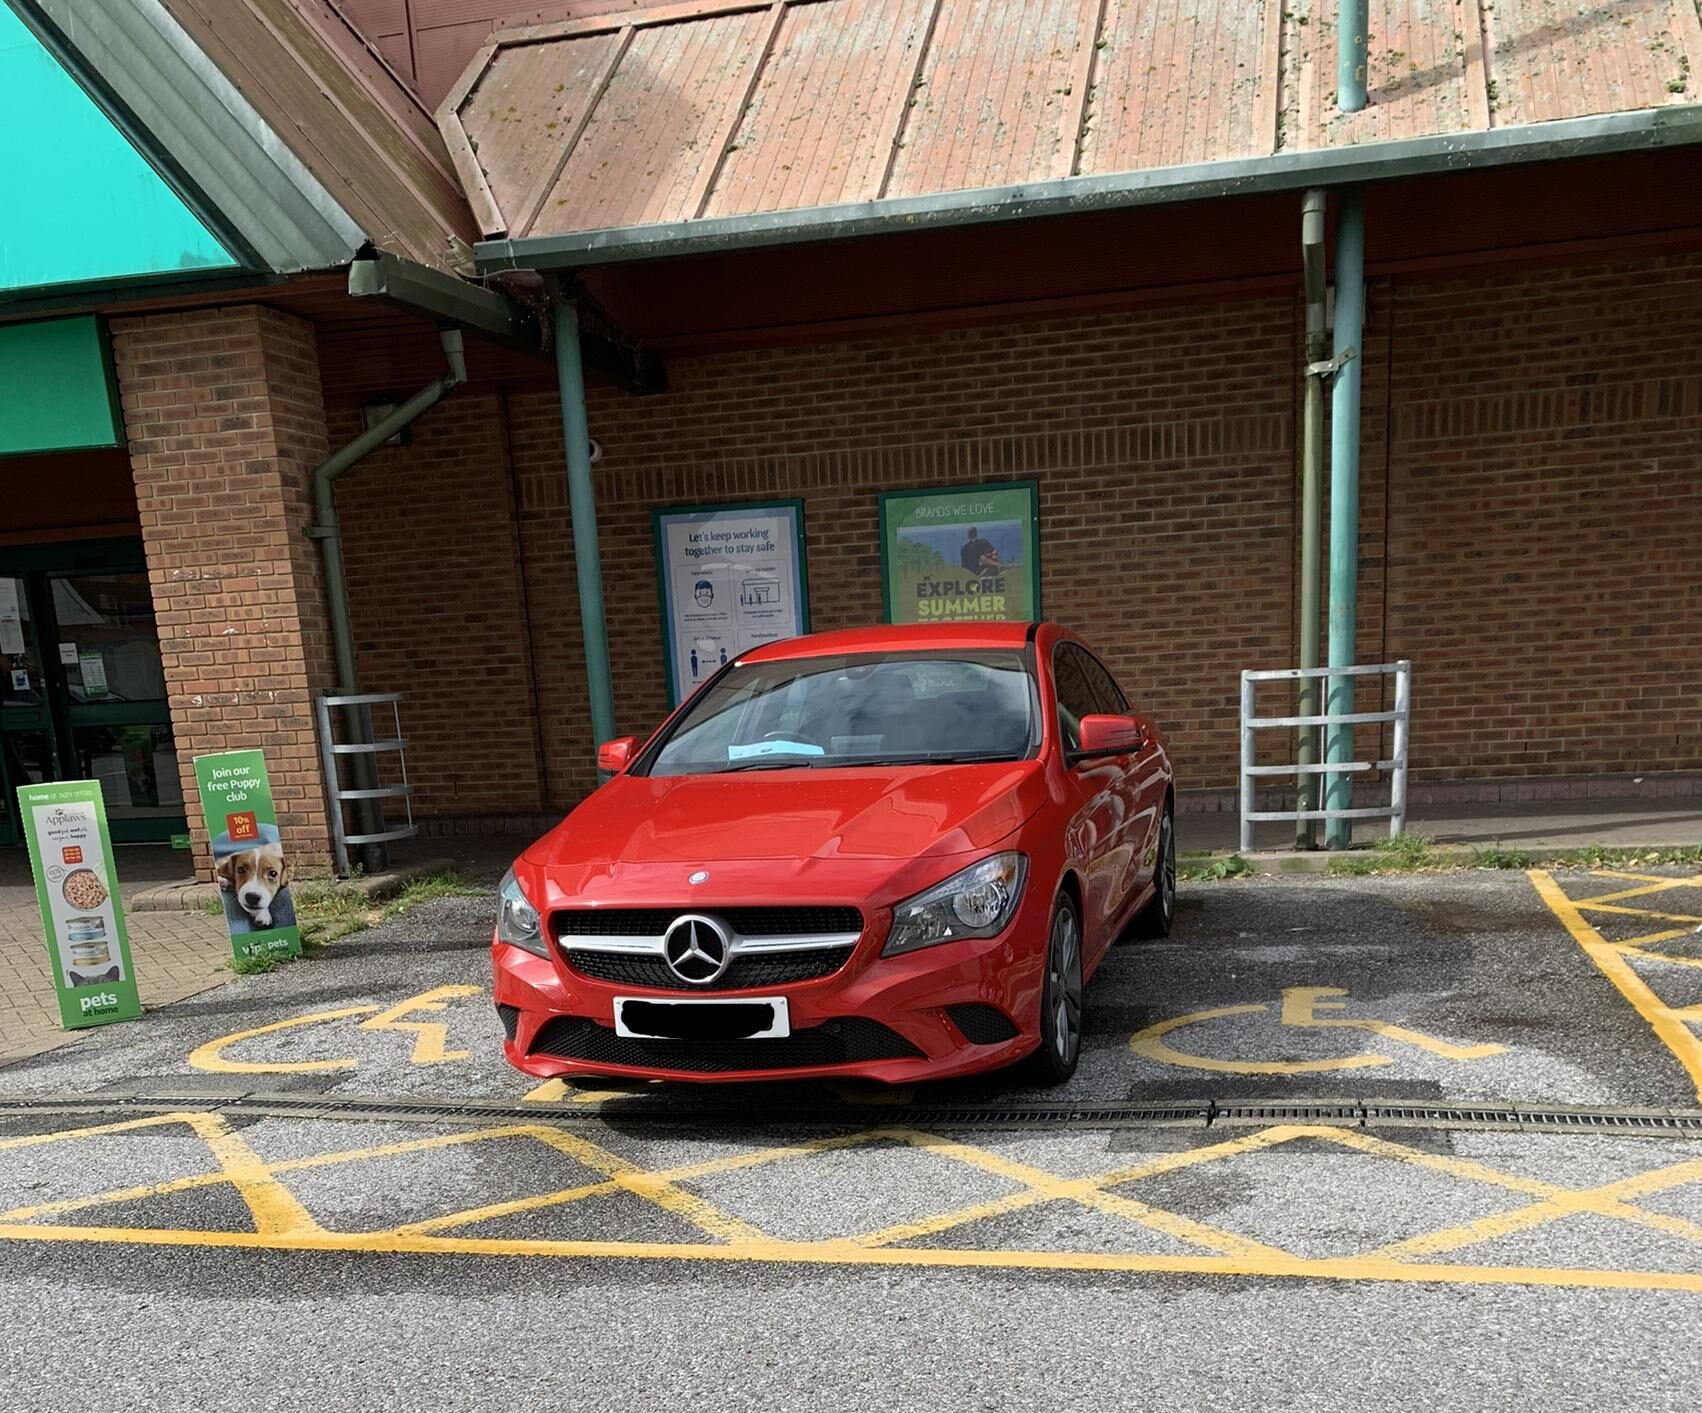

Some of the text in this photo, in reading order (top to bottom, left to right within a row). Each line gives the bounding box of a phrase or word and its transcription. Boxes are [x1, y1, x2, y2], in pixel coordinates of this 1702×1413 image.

[915, 505, 951, 519] BRANDS
[952, 504, 967, 516] WE
[688, 528, 769, 543] Let's keep working
[685, 540, 775, 557] together to stay safe
[916, 577, 1006, 598] EXPLORE
[918, 596, 1006, 617] SUMMER
[212, 768, 231, 779] Join
[207, 778, 261, 792] free Puppy
[226, 791, 247, 802] club
[45, 815, 87, 826] Applaws
[233, 816, 250, 825] 10%
[236, 825, 251, 834] off
[267, 938, 289, 951] pets
[79, 992, 117, 1011] pets
[83, 1006, 119, 1017] at home
